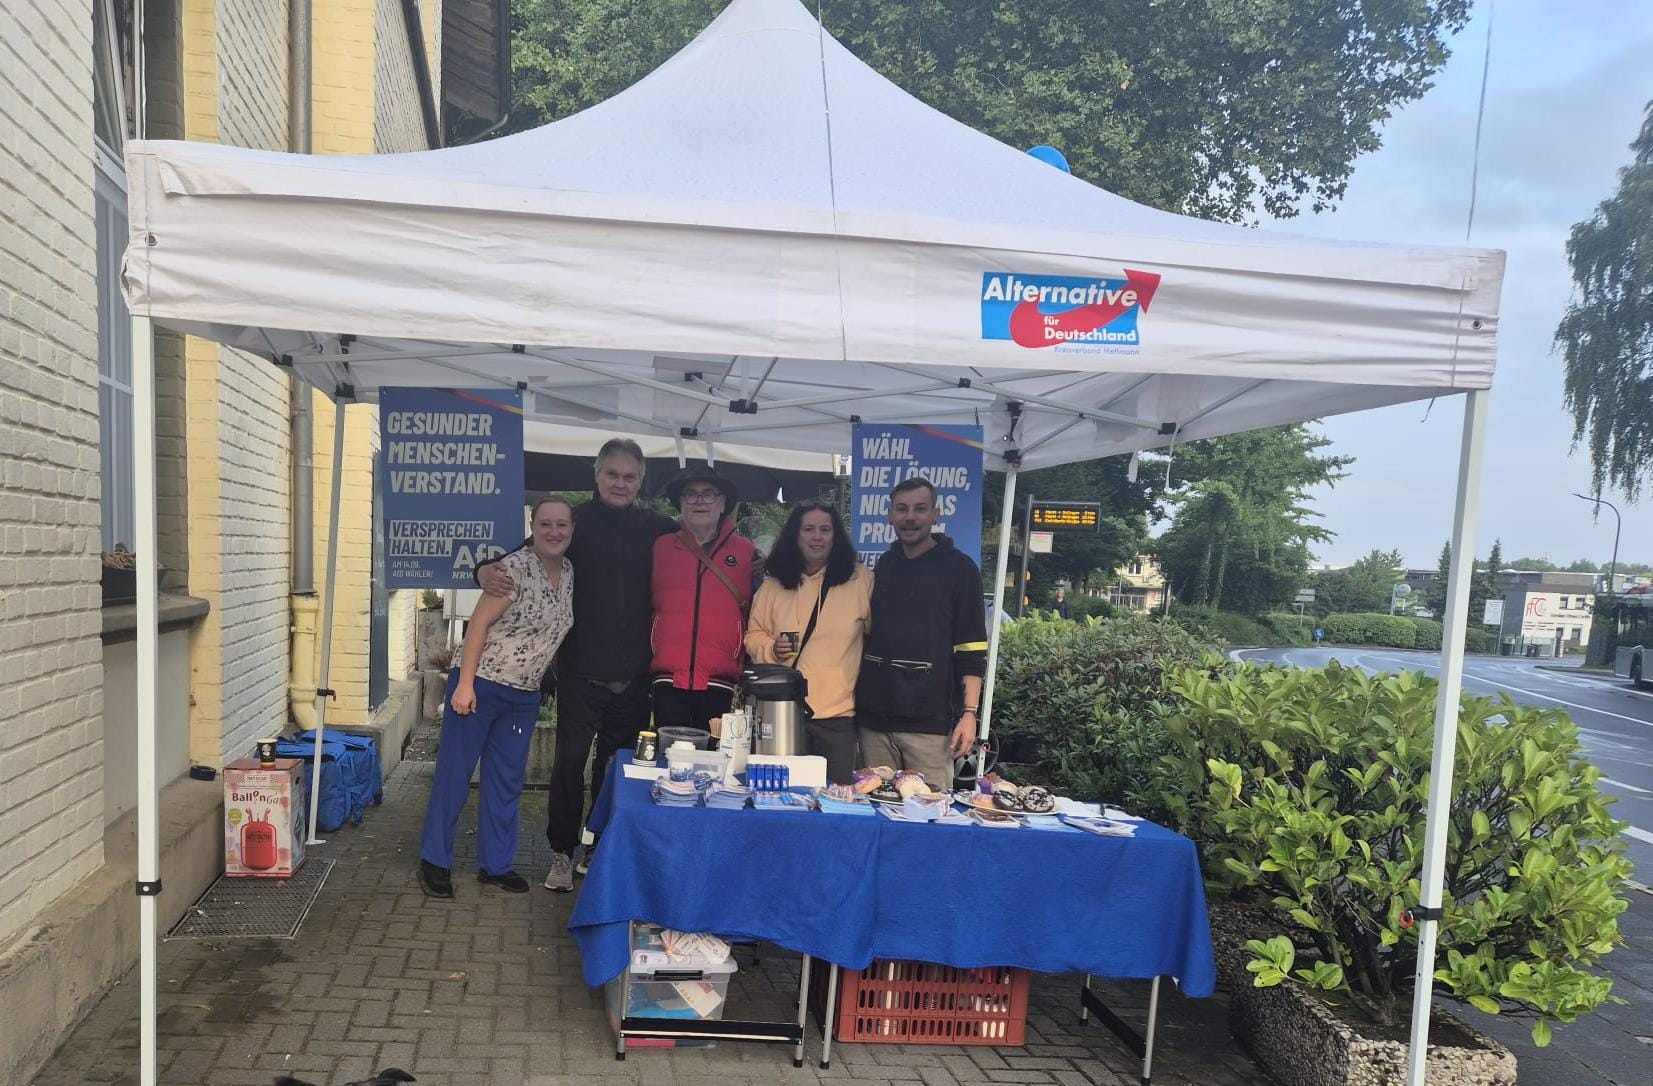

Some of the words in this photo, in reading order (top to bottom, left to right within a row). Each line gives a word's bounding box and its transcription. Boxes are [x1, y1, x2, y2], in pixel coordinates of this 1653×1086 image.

[983, 276, 1138, 307] Alternative
[1043, 315, 1060, 325] für
[1044, 327, 1137, 342] Deutschland
[387, 411, 493, 436] GESUNDER
[387, 441, 506, 466] MENSCHEN-
[862, 432, 914, 460] WÄHL
[390, 471, 501, 495] VERSTAND.
[859, 466, 892, 488] DIE
[391, 521, 491, 539] VERSPRECHEN
[391, 539, 450, 555] HALTEN.
[392, 561, 402, 569] AM
[405, 569, 434, 578] WÄHLEN!
